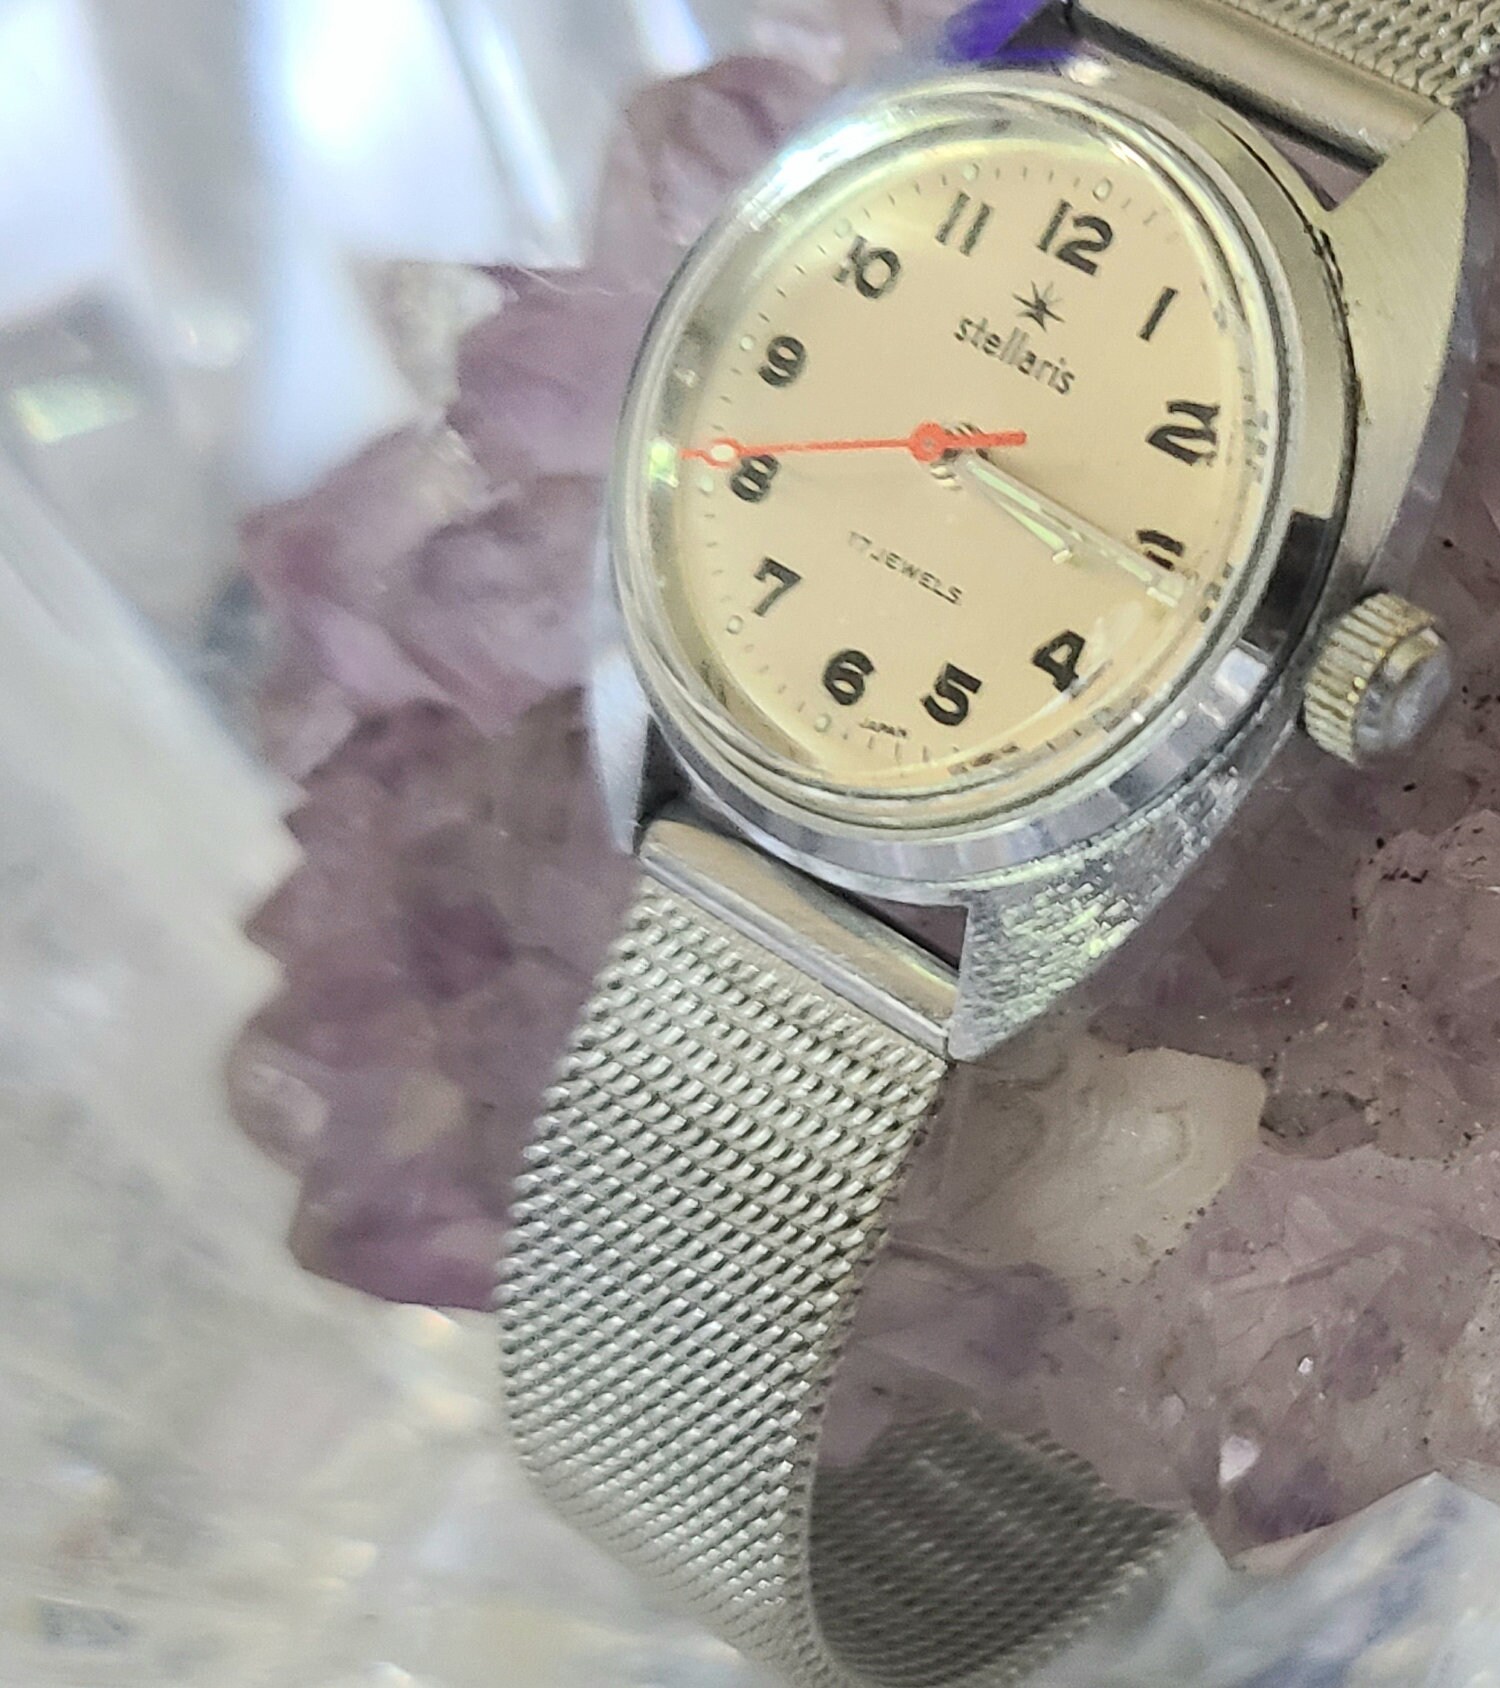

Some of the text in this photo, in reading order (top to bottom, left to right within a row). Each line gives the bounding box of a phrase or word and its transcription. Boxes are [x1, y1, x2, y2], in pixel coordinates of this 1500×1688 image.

[935, 191, 992, 256] 11
[1037, 199, 1114, 276] 12
[833, 235, 901, 299] 10
[1138, 286, 1179, 342] 1
[757, 335, 807, 387] 9
[953, 316, 1076, 395] stellaris
[1145, 400, 1221, 466] 2
[729, 453, 780, 503] 8
[753, 556, 803, 617] 7
[869, 548, 963, 606] JEWELS
[822, 649, 876, 706] 6
[1031, 629, 1087, 693] 4
[919, 662, 983, 727] 5
